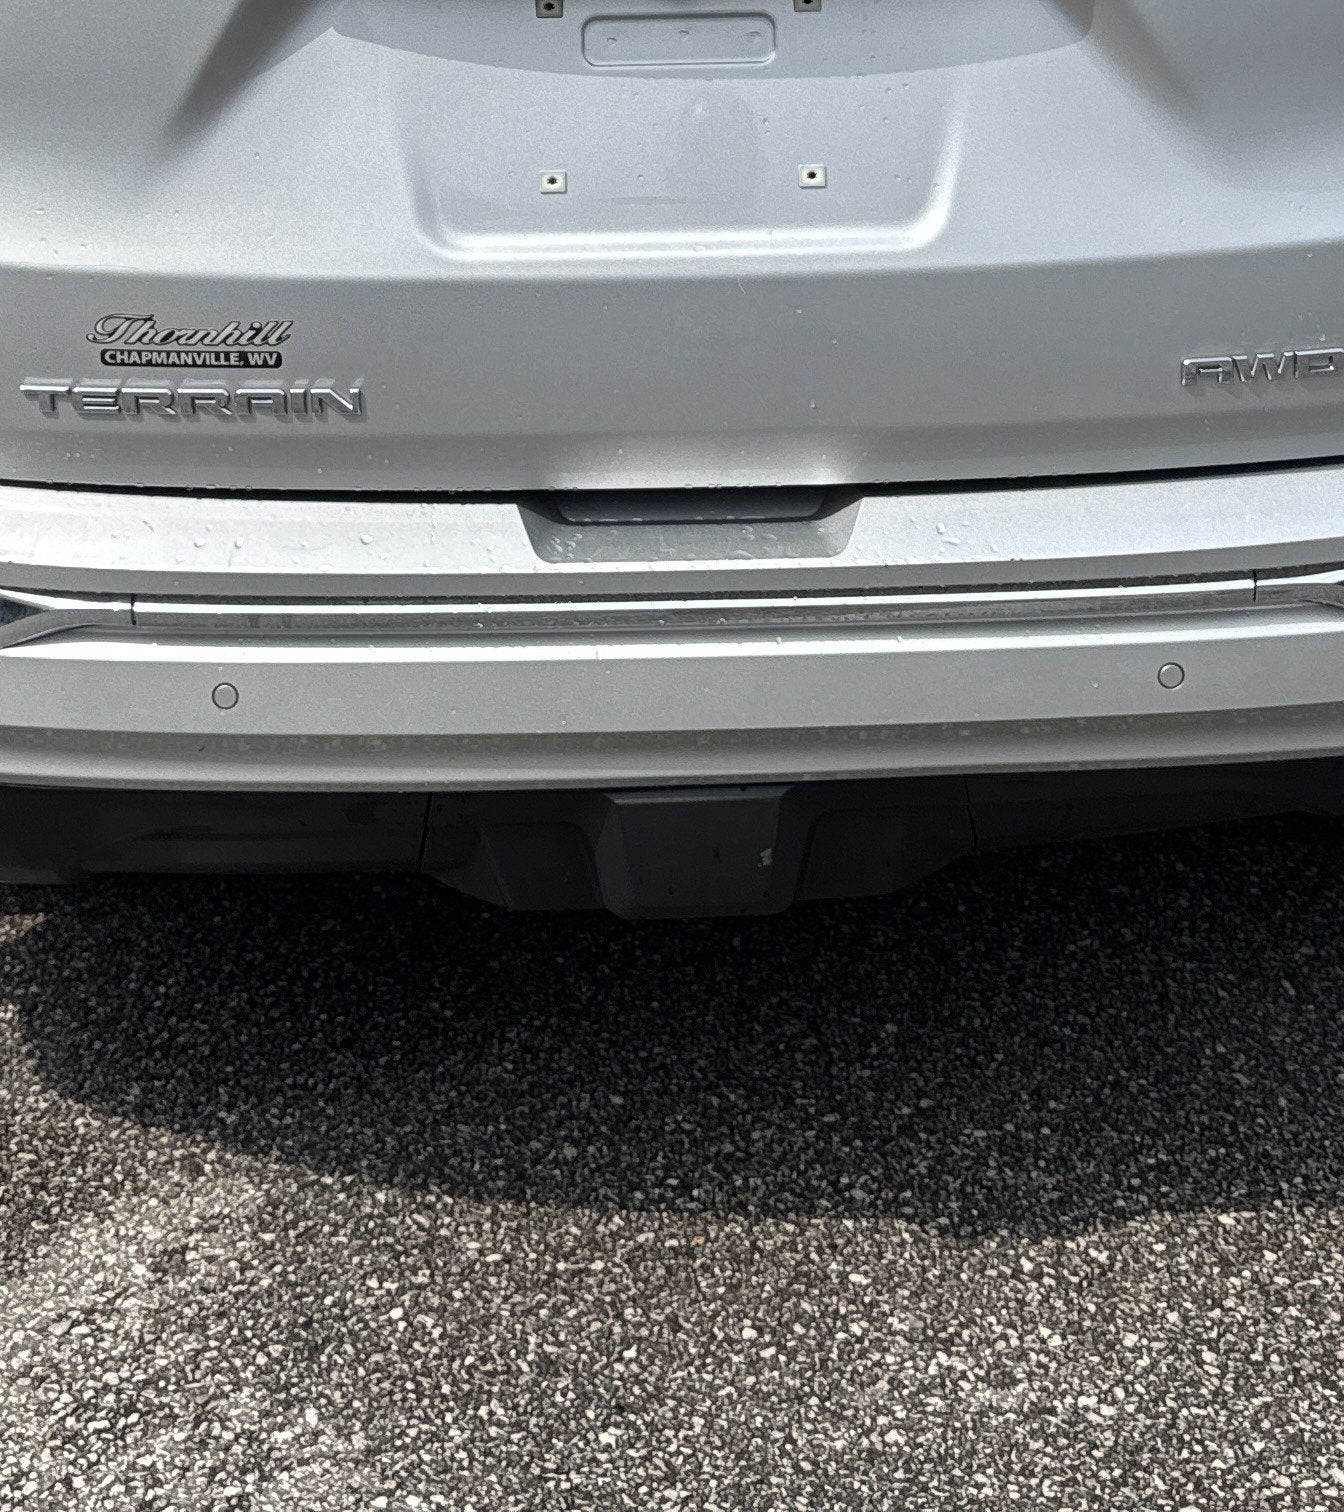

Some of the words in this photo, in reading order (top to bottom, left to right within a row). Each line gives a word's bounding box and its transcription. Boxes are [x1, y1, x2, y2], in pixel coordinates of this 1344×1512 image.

[86, 313, 294, 346] Thornhill
[104, 350, 244, 366] CHAPMANVILLE,
[248, 351, 278, 366] WV
[1181, 347, 1344, 386] AWD
[19, 382, 362, 416] TERRAIN
